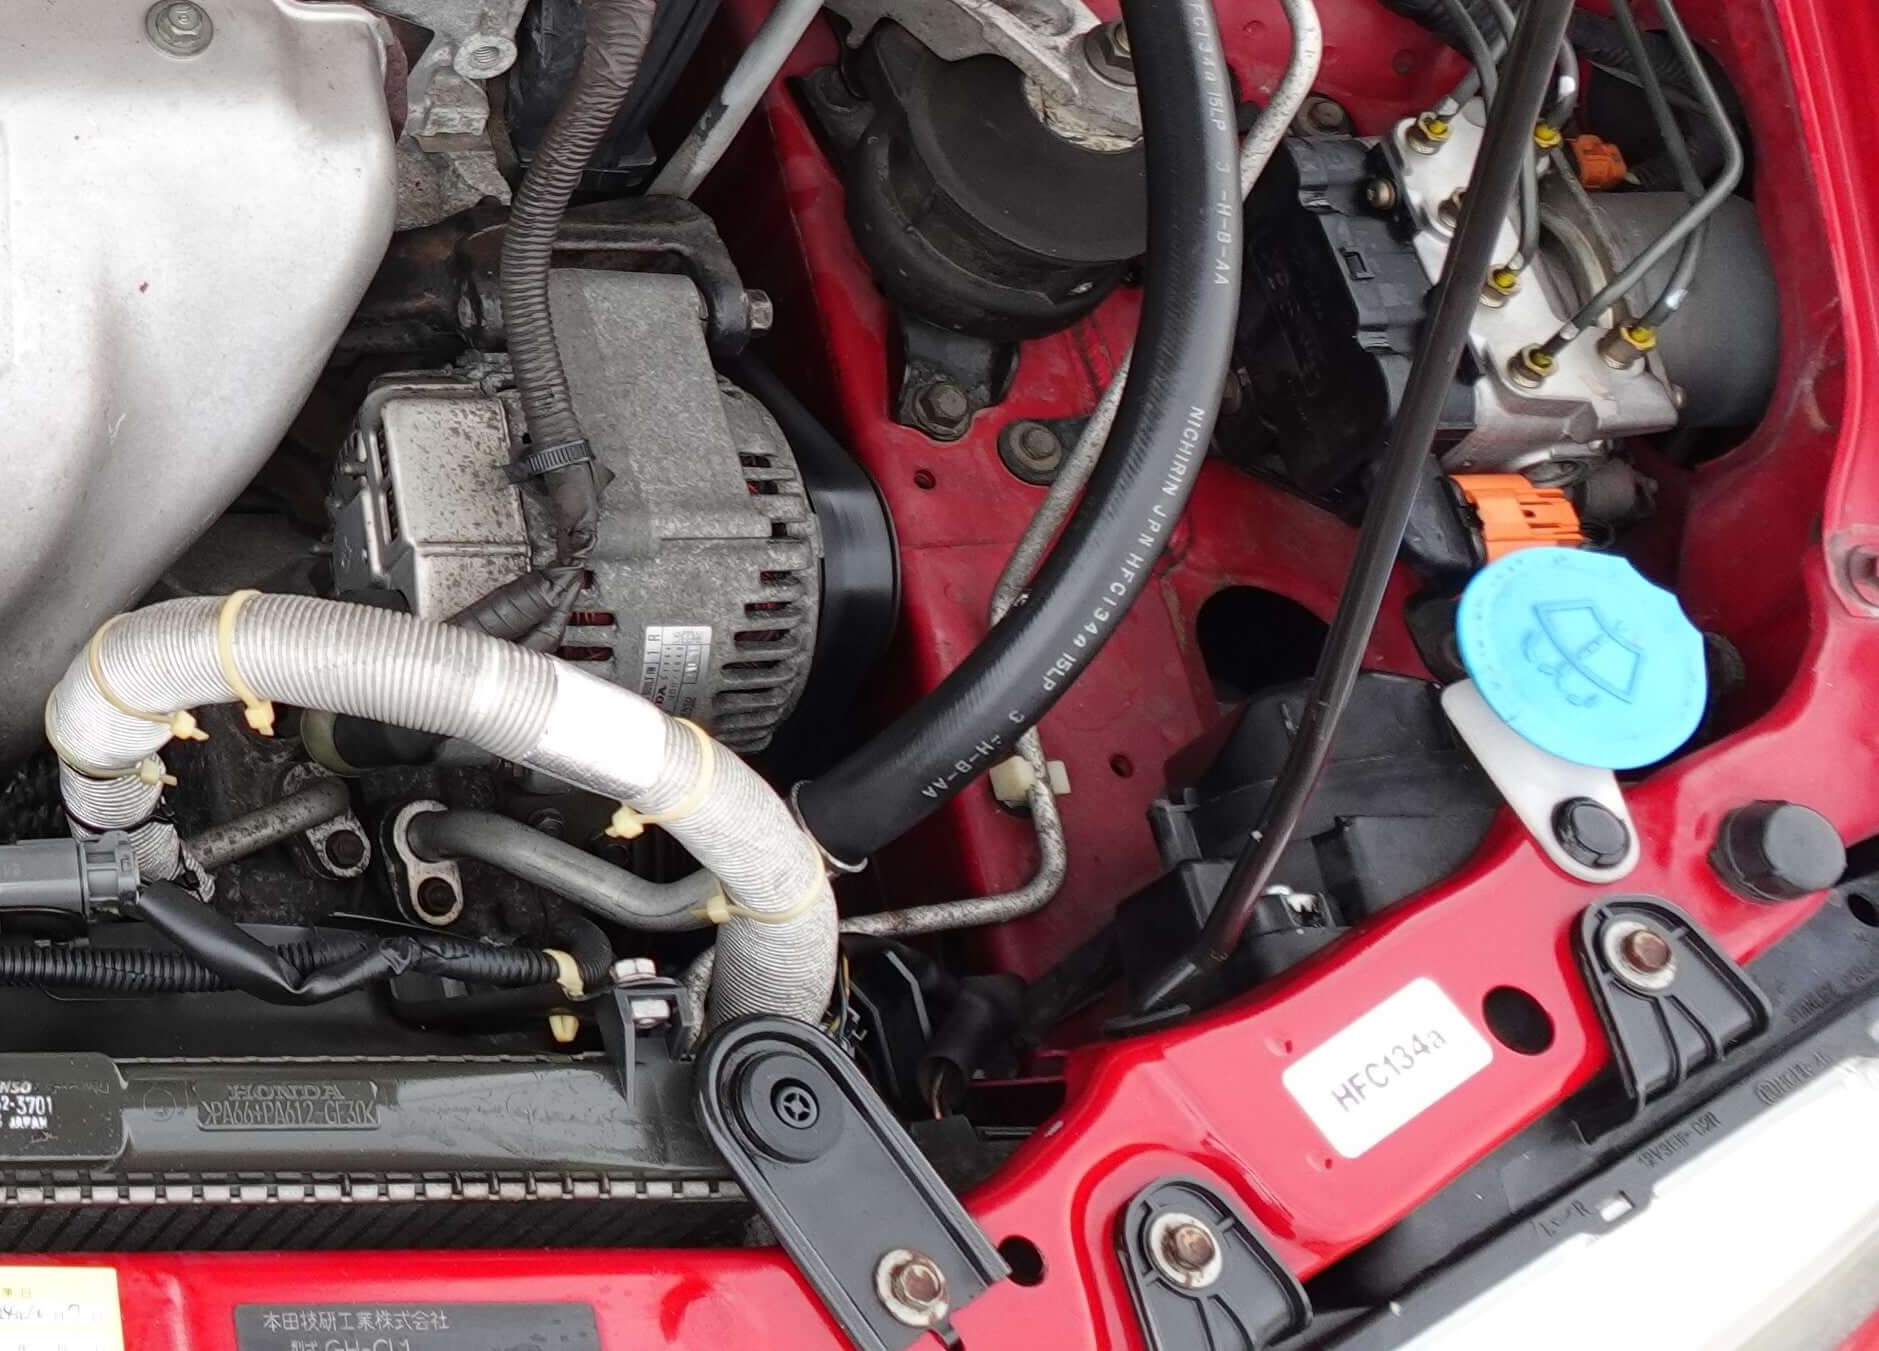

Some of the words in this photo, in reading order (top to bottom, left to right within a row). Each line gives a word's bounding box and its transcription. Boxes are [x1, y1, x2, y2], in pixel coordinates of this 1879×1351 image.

[1161, 405, 1207, 498] NICHIRIN
[1138, 504, 1168, 548] JPN
[1072, 552, 1146, 649] HFC134a
[226, 1084, 344, 1101] HONDA
[1330, 1029, 1450, 1113] HFC134a
[263, 1309, 450, 1331] 本田技研工業株式会社
